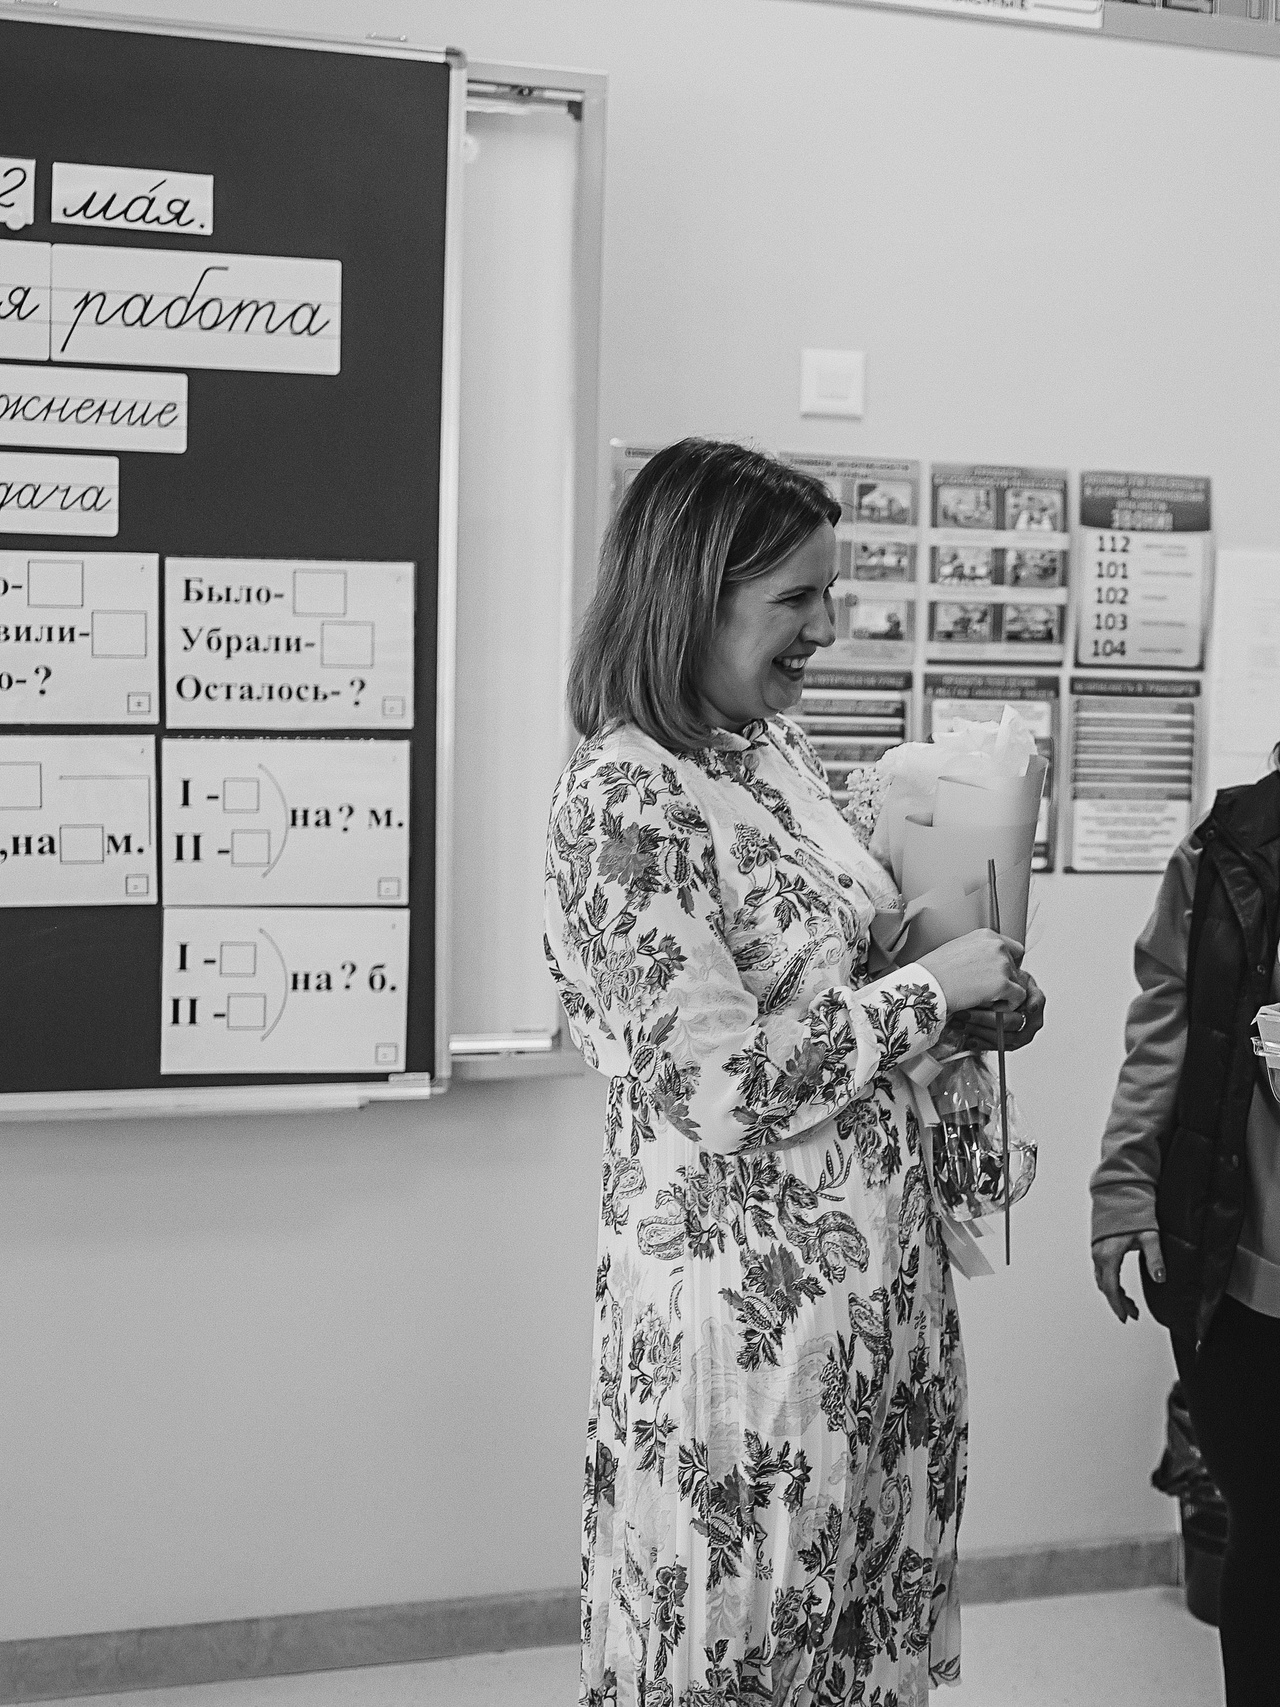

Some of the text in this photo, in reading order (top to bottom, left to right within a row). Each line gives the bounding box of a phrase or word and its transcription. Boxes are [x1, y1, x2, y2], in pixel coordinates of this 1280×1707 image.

[0, 166, 27, 208] 2
[60, 266, 331, 353] работа
[1098, 535, 1131, 553] 112
[1097, 561, 1128, 579] 101
[183, 577, 285, 604] Было-
[1097, 586, 1129, 605] 102
[1095, 613, 1127, 631] 103
[181, 626, 316, 661] Убрали-
[1093, 639, 1127, 657] 104
[105, 835, 145, 856] м.
